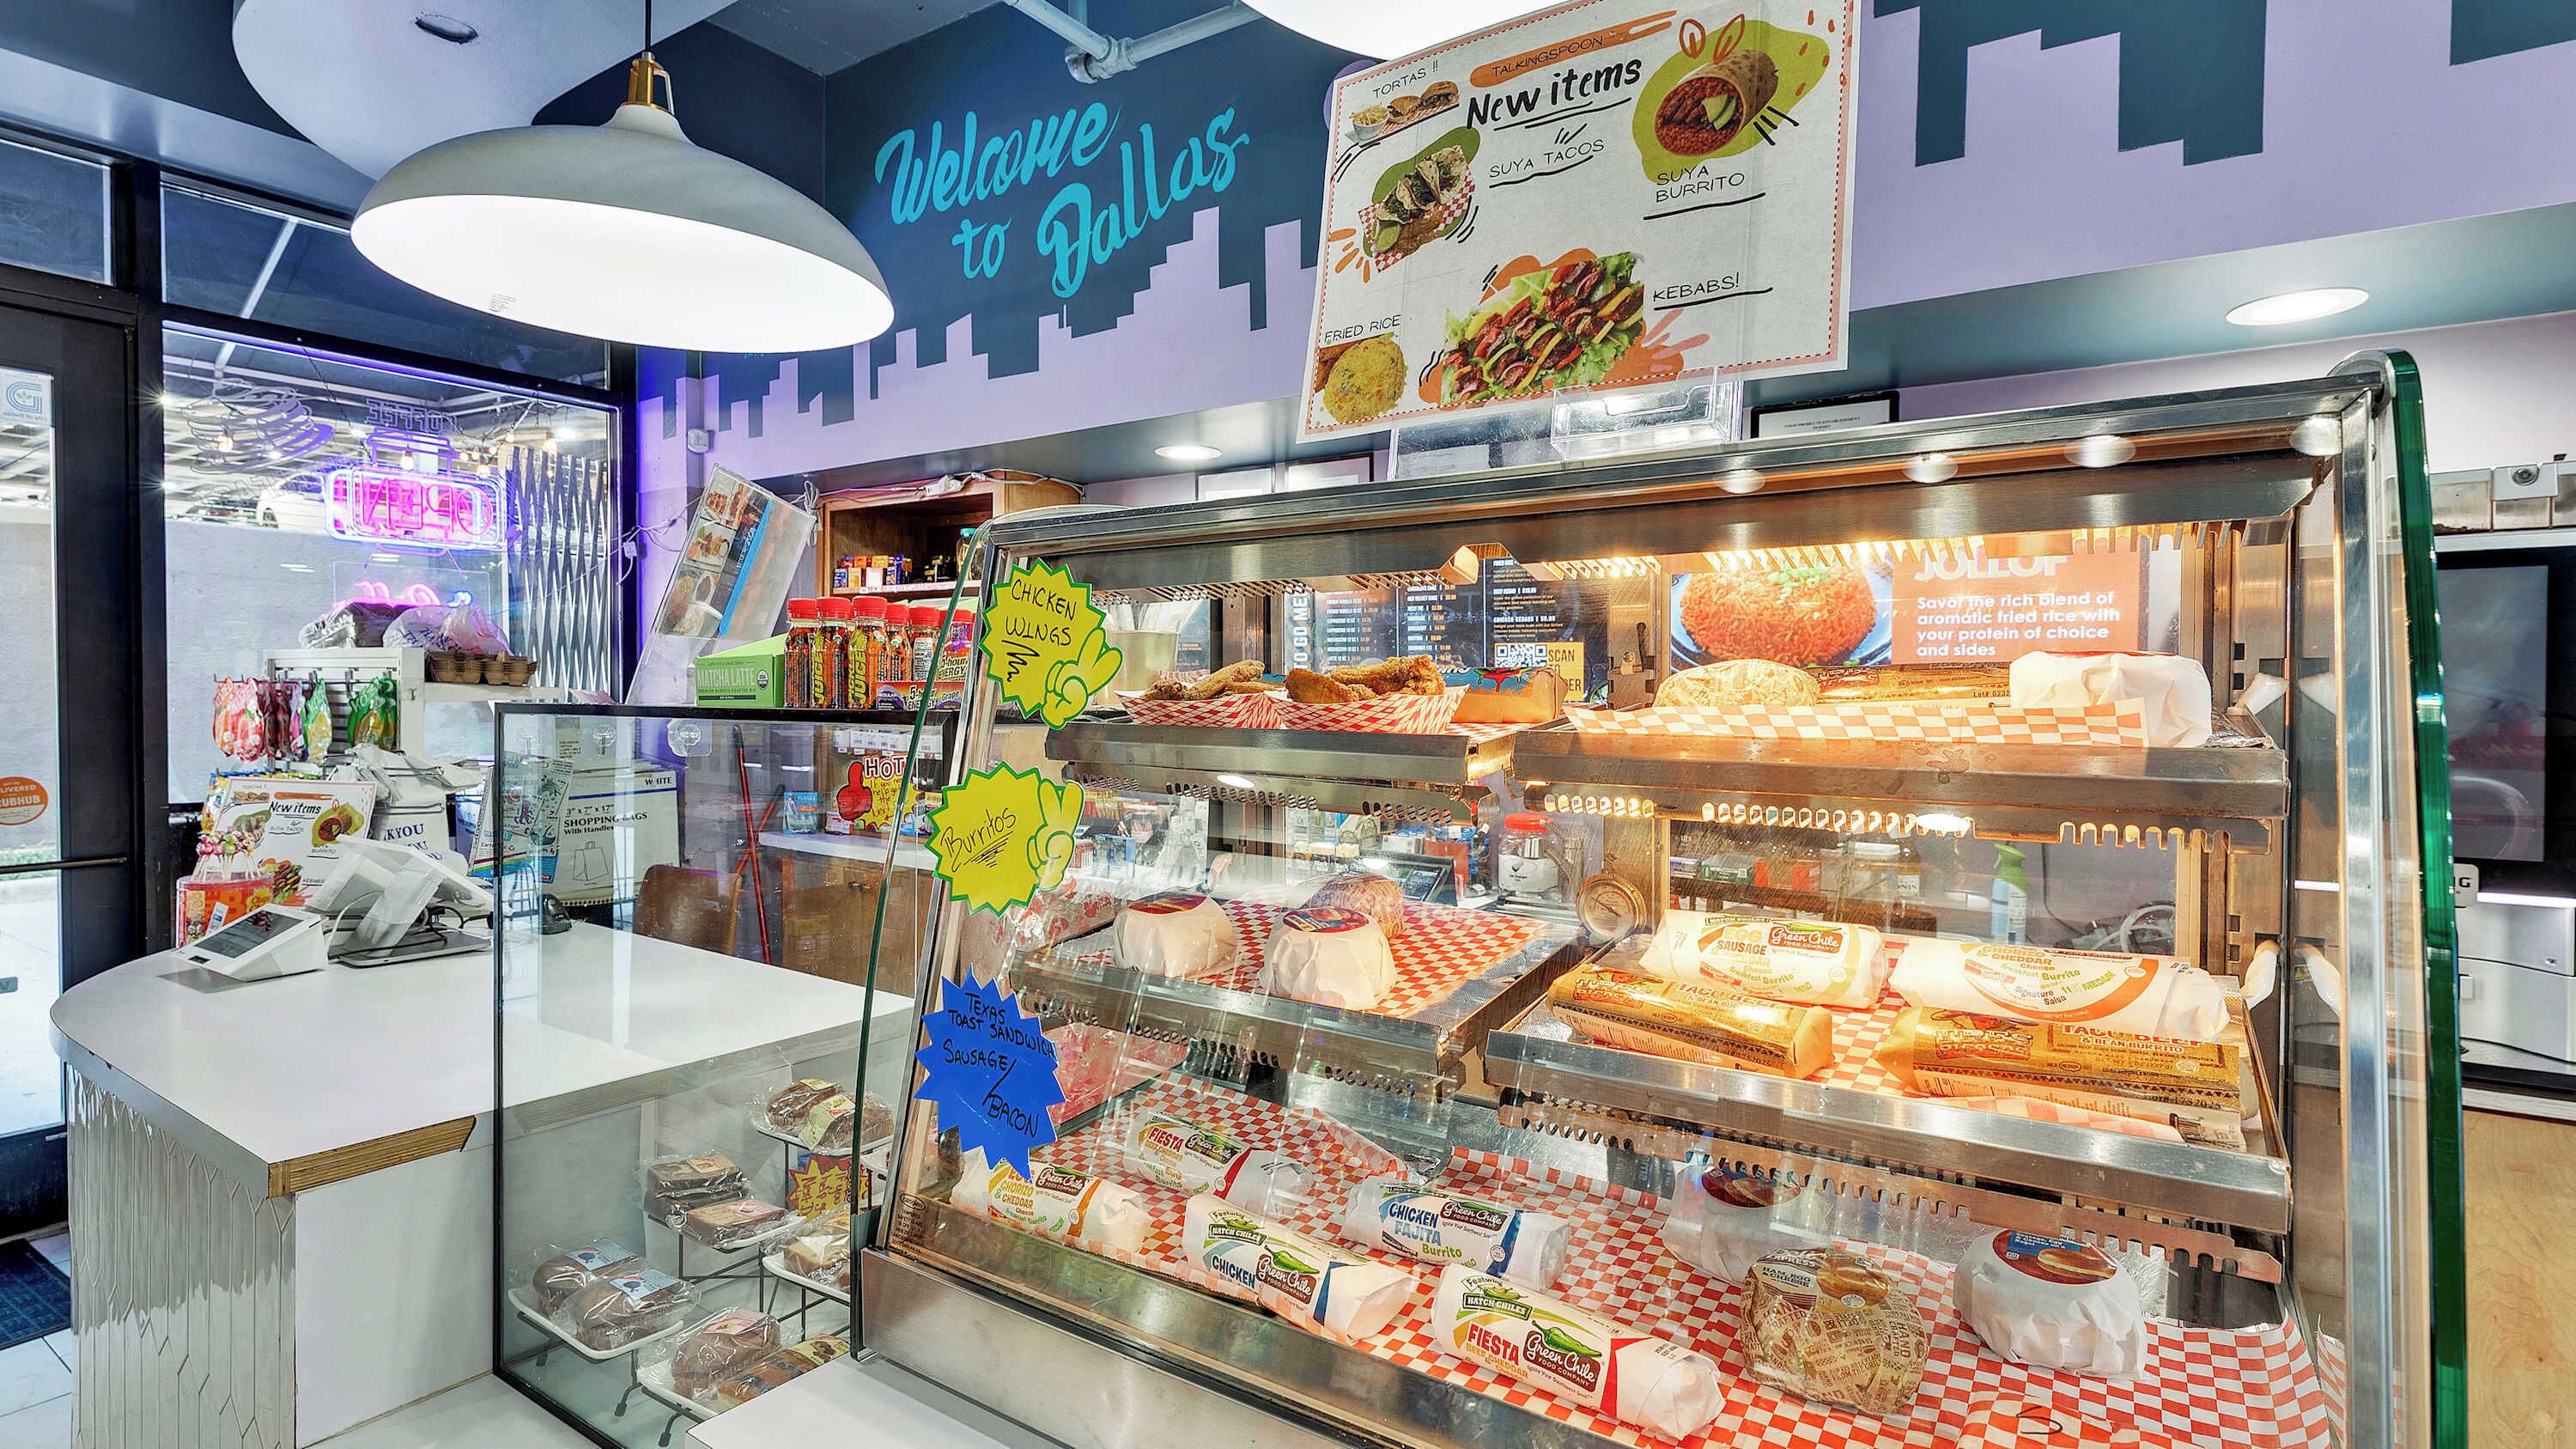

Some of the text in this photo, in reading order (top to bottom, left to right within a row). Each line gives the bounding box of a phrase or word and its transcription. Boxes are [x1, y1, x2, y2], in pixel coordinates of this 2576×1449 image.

[1492, 35, 1604, 77] TALKINGSPOON
[1373, 68, 1427, 100] TORTAS
[1467, 58, 1642, 130] New items
[875, 102, 1121, 225] Welcome
[1489, 139, 1605, 179] SUYA TACOS
[1656, 165, 1710, 186] SUYA
[1655, 173, 1745, 204] BURRITO
[1036, 107, 1250, 298] Dallas
[951, 217, 1012, 279] to
[1652, 272, 1741, 303] KEBABS!
[1323, 314, 1401, 344] FRIED RICE
[1011, 579, 1077, 622] CHICKEN
[1917, 590, 2116, 610] Savor the rich blend of
[1917, 608, 2120, 625] aromatic fried rice with
[1005, 616, 1072, 646] WINGS
[1292, 626, 1309, 647] GO
[1917, 626, 2110, 643] your protein of choice
[1548, 649, 1575, 662] SCAN
[1917, 644, 1996, 656] and sides
[697, 667, 755, 688] MATCHA LATTE
[814, 651, 824, 704] JUICE
[854, 650, 867, 705] JUICE
[909, 684, 937, 702] 5-hr
[941, 690, 960, 702] Grape
[907, 699, 937, 711] ENEGY
[0, 795, 41, 807] UBHUB
[269, 801, 321, 813] New items
[563, 815, 620, 828] SHOPPING
[564, 826, 582, 836] With
[939, 807, 1017, 864] Burritos
[1722, 926, 1763, 943] EGG
[1771, 927, 1839, 947] Green Chile
[1716, 939, 1767, 956] SAUSAGE
[1801, 941, 1834, 953] COMPANY
[1982, 946, 2046, 958] CHORIZO
[1990, 953, 2054, 966] CHEDDAR
[2020, 963, 2057, 971] Cheese
[1762, 973, 1794, 985] Burrito
[1999, 963, 2039, 978] Breakfast
[2041, 969, 2081, 981] Burrito
[2081, 971, 2117, 991] MEDIUM
[1676, 983, 1722, 999] TACO
[1696, 995, 1721, 1006] BEAN
[2014, 985, 2055, 999] Signature
[2044, 995, 2067, 1006] Salsa
[965, 992, 1006, 1026] TEXAS
[948, 1009, 984, 1032] TOAST
[2061, 1024, 2117, 1038] TACO
[989, 1023, 1057, 1062] SANDWICH
[2081, 1037, 2184, 1054] & BEAN BURRITO
[987, 1093, 1039, 1138] BACON
[1147, 1127, 1184, 1153] FIESTA
[1038, 1167, 1064, 1186] Green
[994, 1188, 1002, 1200] &
[1001, 1195, 1034, 1209] CHEDDAR
[999, 1180, 1034, 1197] CHORIZO
[1212, 1210, 1245, 1220] Featuring
[1388, 1202, 1439, 1228] CHICKEN
[1444, 1202, 1503, 1226] Green Chile
[1453, 1214, 1497, 1228] FOOD COMPANY
[1212, 1226, 1262, 1242] HATCH CHILES
[1394, 1221, 1442, 1246] FAJITA
[2014, 1238, 2035, 1246] Bagel
[2020, 1237, 2050, 1245] Cheese
[1421, 1243, 1462, 1258] Burrito
[1212, 1254, 1256, 1289] CHICKEN
[1258, 1254, 1313, 1296] Green Chile
[1767, 1272, 1810, 1288] CHEESE
[1789, 1272, 1812, 1283] EGG
[1267, 1277, 1308, 1300] FOOD COMPANY
[1466, 1276, 1504, 1288] Featuring
[1467, 1295, 1527, 1315] HATCH CHILES
[1467, 1323, 1520, 1366] FIESTA
[1888, 1320, 1900, 1357] CRAFTED
[1896, 1322, 1911, 1359] HAND
[1488, 1355, 1529, 1379] CHEDDAR
[1525, 1334, 1595, 1383] Green Chile
[1538, 1357, 1589, 1387] FOOD COMPANY
